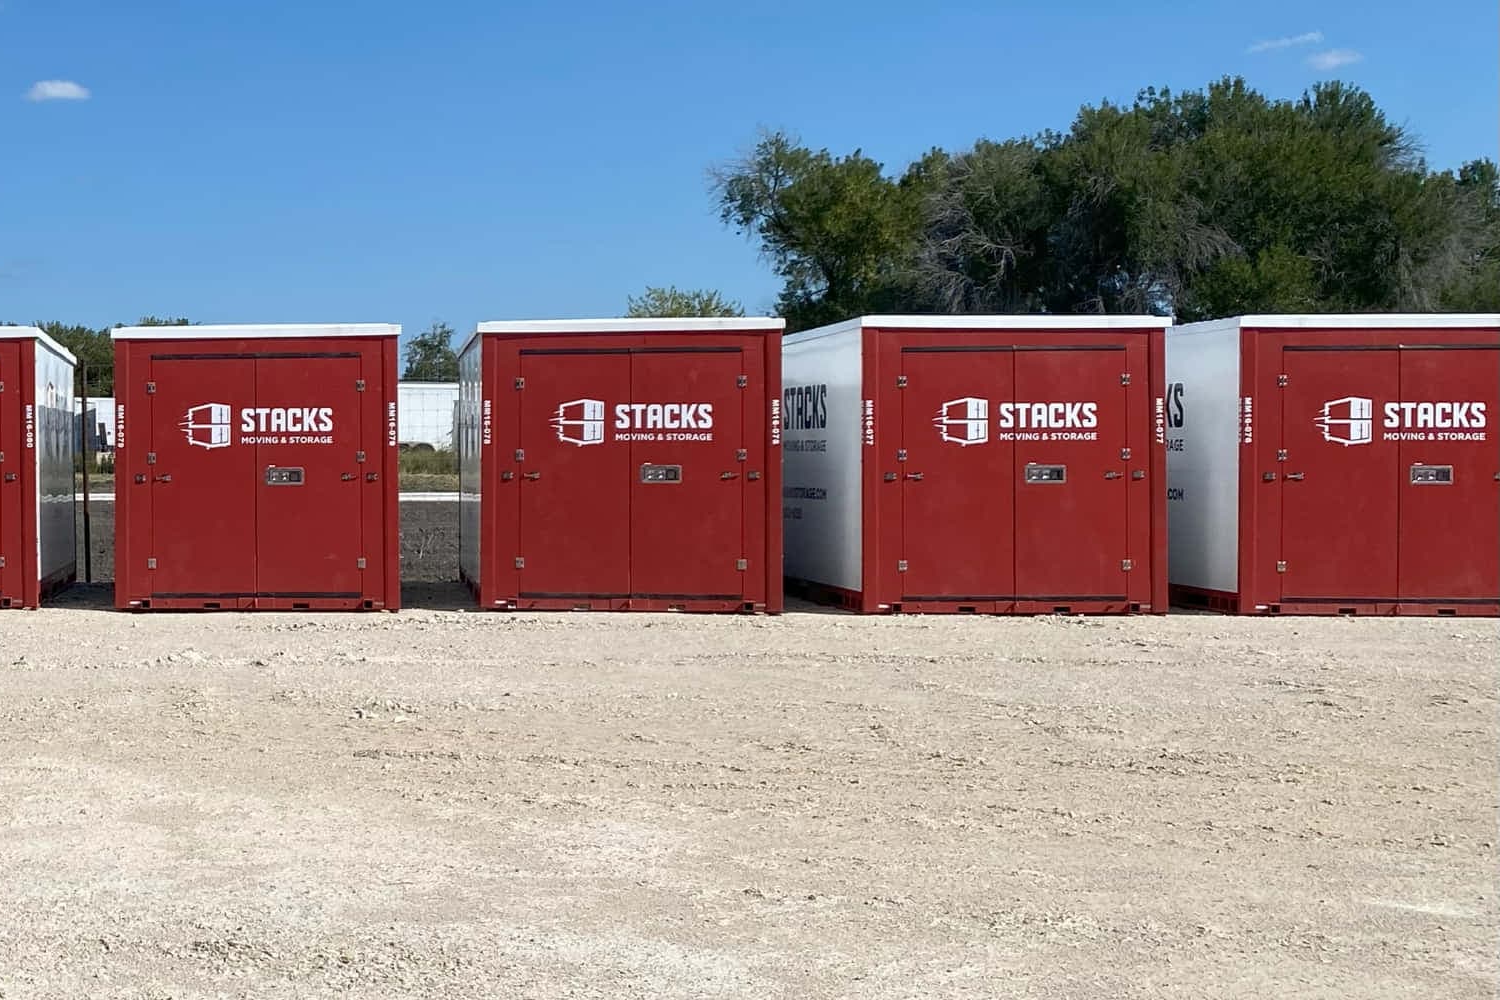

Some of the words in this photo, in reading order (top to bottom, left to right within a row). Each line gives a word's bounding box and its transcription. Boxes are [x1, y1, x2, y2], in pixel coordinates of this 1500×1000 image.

[614, 403, 713, 429] STACKS
[783, 383, 827, 430] STACKS
[999, 402, 1098, 429] STACKS
[1383, 401, 1486, 429] STACKS
[241, 407, 333, 433] STACKS
[241, 435, 279, 445] MOVING
[280, 435, 287, 445] &
[288, 435, 333, 445] STORAGE
[615, 432, 656, 441] MOVING
[656, 432, 664, 441] &
[665, 432, 713, 441] STORAGE
[999, 431, 1040, 441] MOVING
[1041, 431, 1049, 441] &
[1050, 431, 1098, 441] STORAGE
[1383, 432, 1426, 441] MOVING
[1427, 432, 1436, 441] &
[1436, 432, 1486, 441] STORAGE
